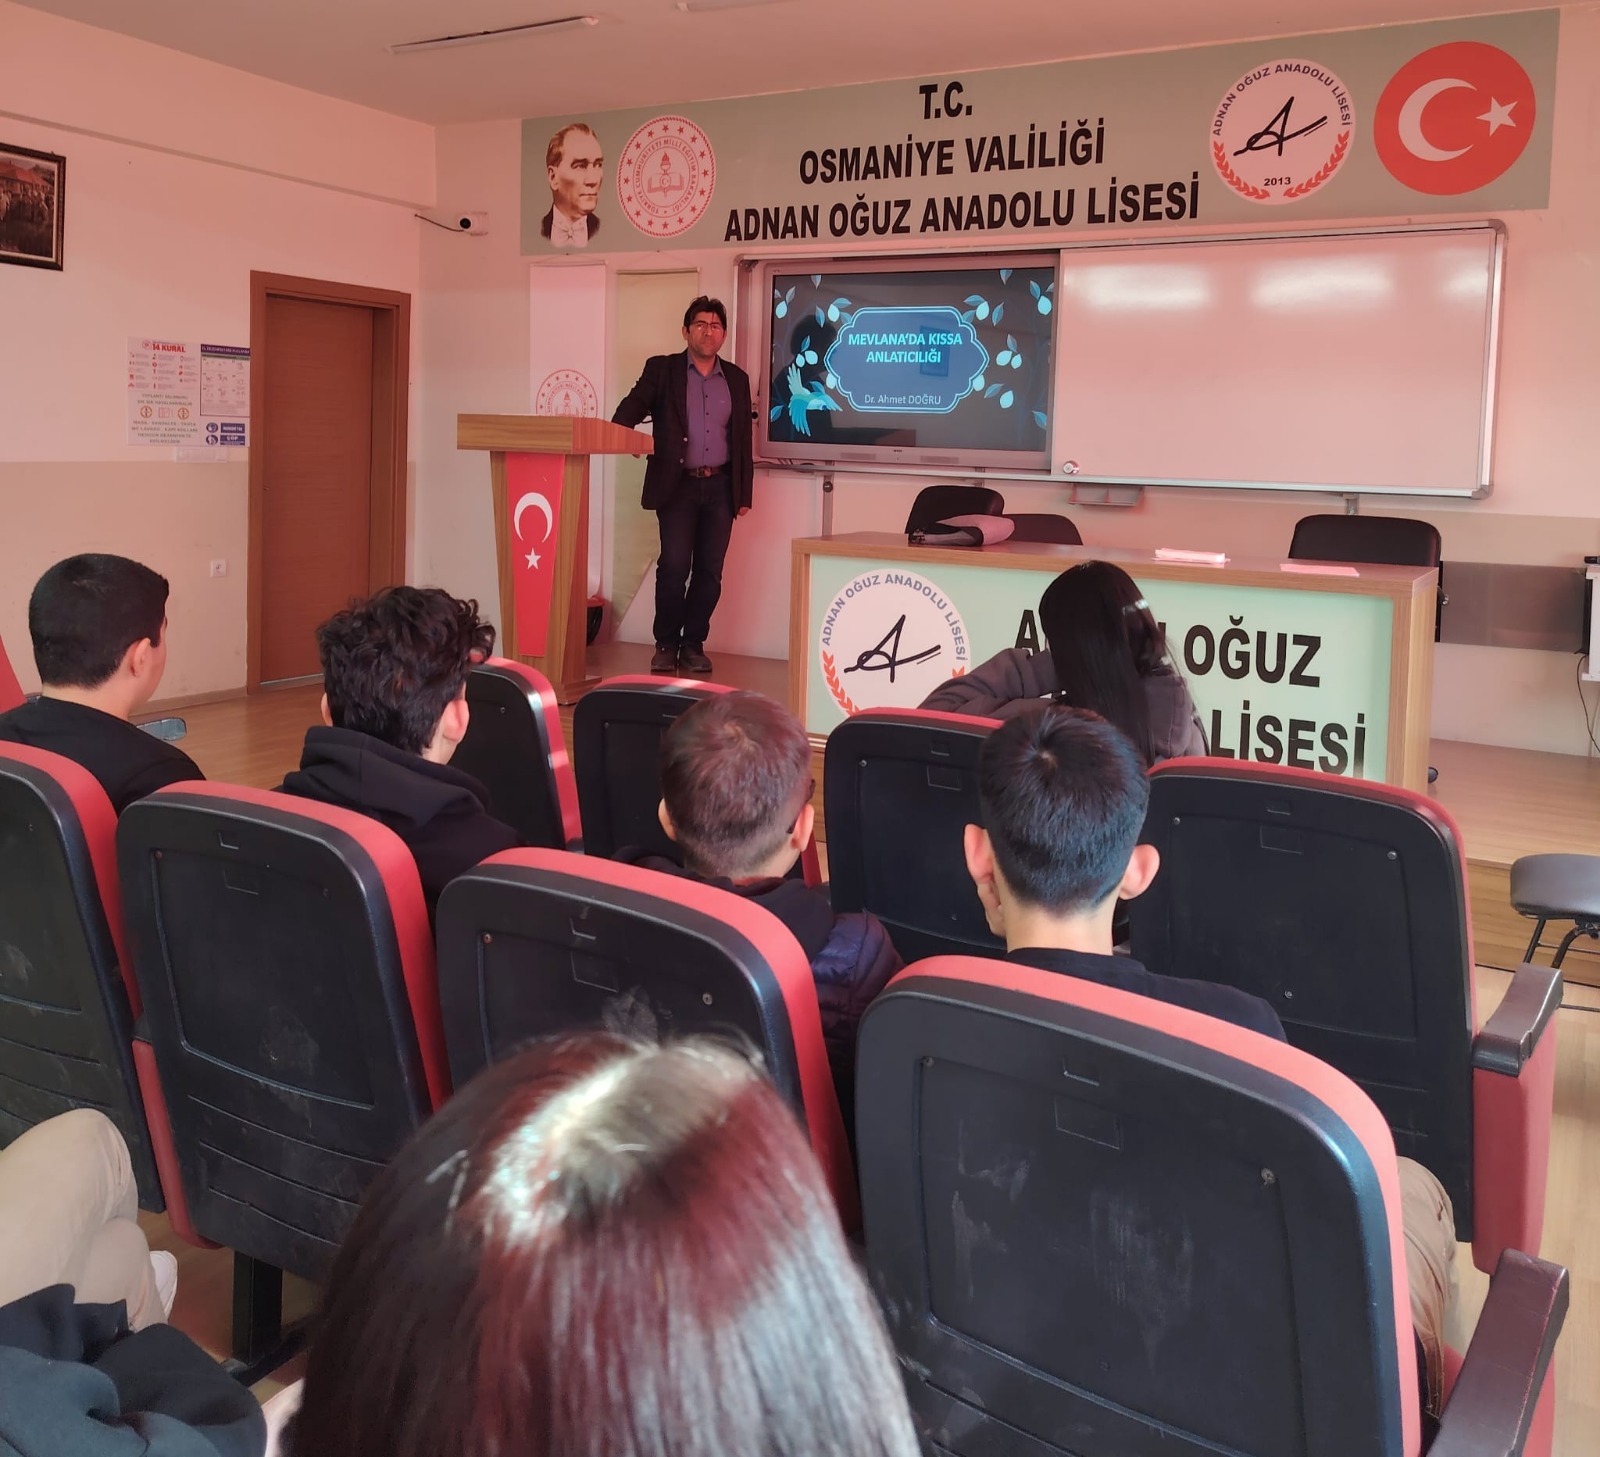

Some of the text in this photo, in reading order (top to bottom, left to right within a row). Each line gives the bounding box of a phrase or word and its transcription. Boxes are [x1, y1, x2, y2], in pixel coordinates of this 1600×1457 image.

[919, 81, 973, 120] T.C.
[1213, 63, 1353, 136] ADNAN OĞUZ ANADOLU LİSESİ
[799, 118, 1106, 185] OSMANİYE VALİLİĞİ
[724, 171, 1200, 242] ADNAN OĞUZ ANADOLU LİSESİ
[1263, 177, 1291, 187] 2013
[152, 343, 186, 353] 14 KURAL
[848, 332, 963, 346] MEVLANA'DA KISSA
[866, 348, 942, 364] ANLATICILIĞI
[864, 392, 942, 405] Dr. Ahmet DOĞRU
[822, 597, 846, 646] ADNAN
[845, 574, 881, 599] OĞUZ
[884, 573, 948, 611] ANADOLU
[944, 611, 968, 660] LİSESİ
[1183, 615, 1321, 688] OĞUZ
[1210, 700, 1365, 778] LİSESİ
